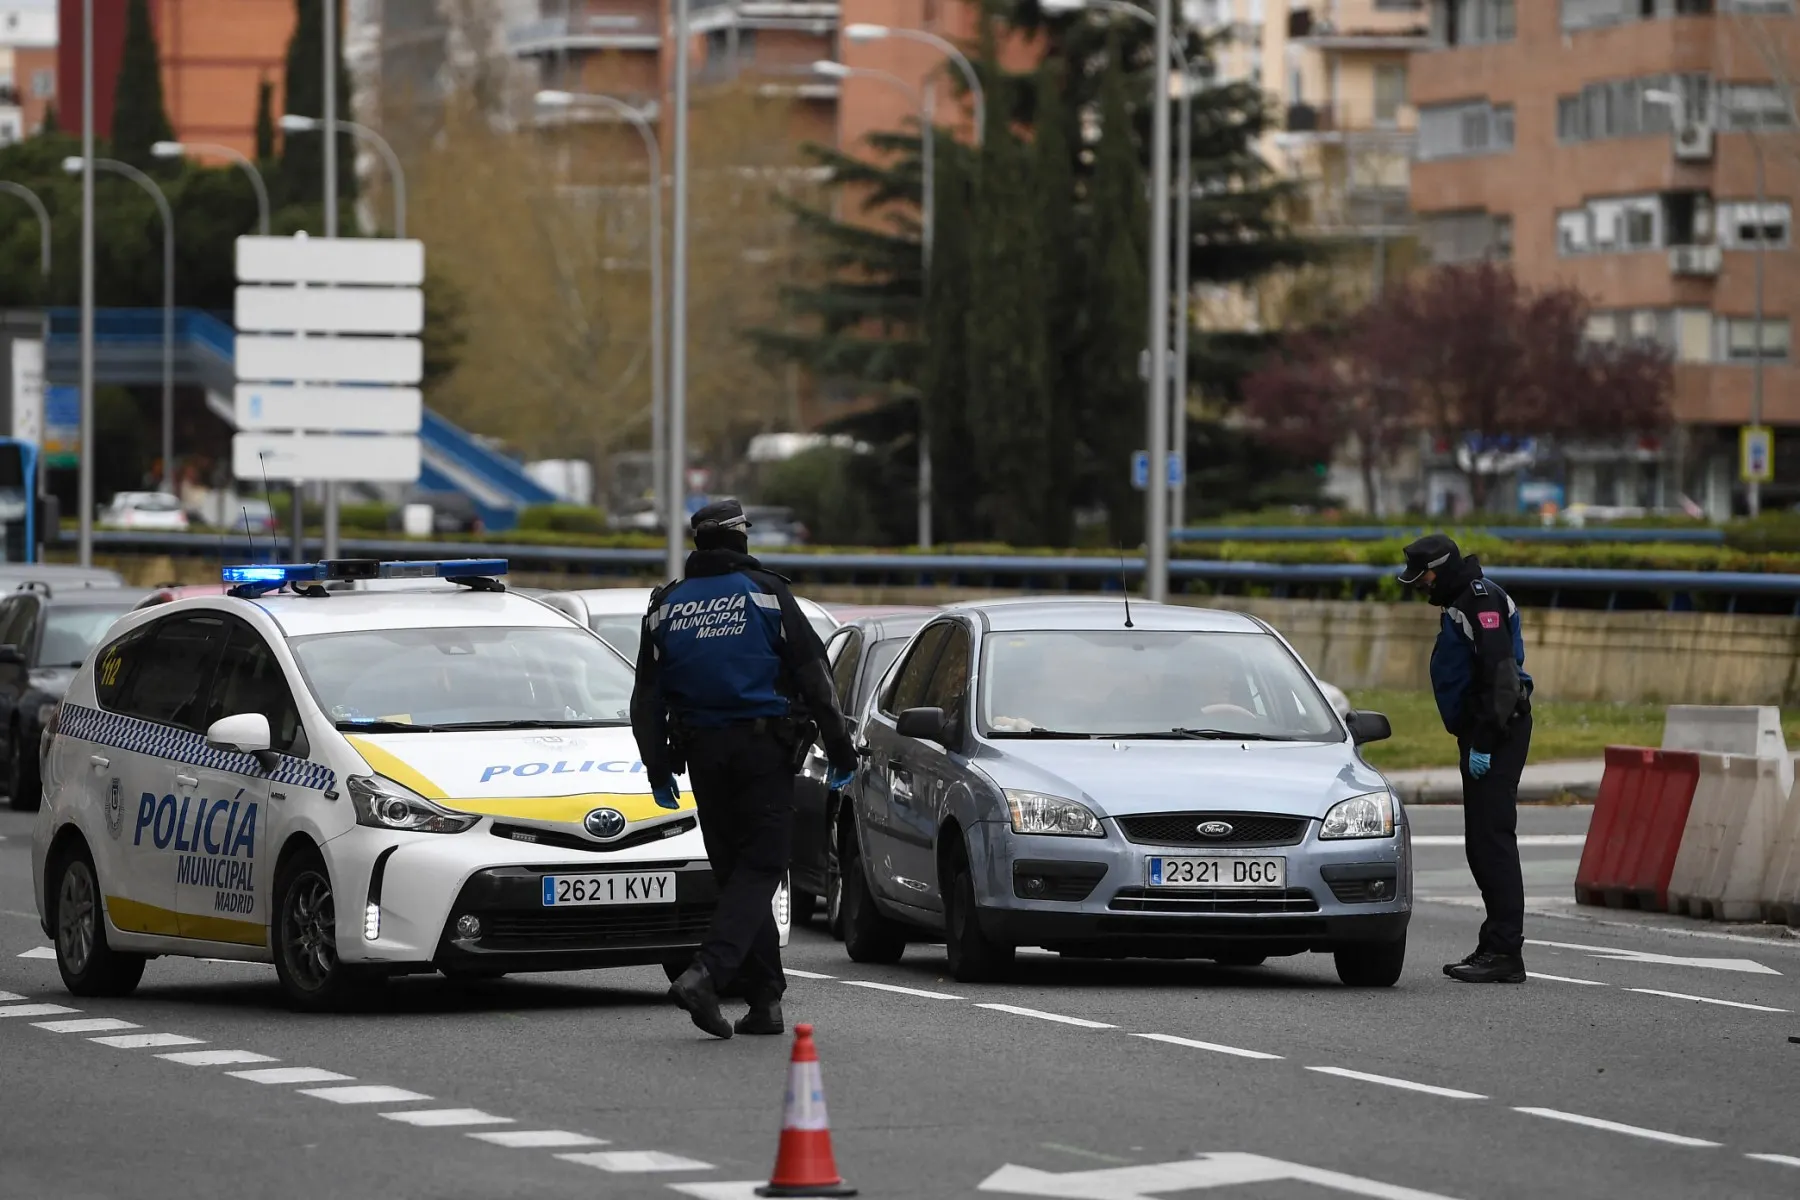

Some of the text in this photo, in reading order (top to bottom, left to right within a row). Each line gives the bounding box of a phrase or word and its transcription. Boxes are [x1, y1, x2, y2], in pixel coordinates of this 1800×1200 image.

[669, 593, 746, 618] POLICÍA
[670, 611, 747, 631] MUNICIPAL
[696, 623, 746, 638] Madrid
[101, 657, 121, 685] 112
[133, 788, 258, 858] POLICÍA
[1205, 824, 1224, 833] Ford
[177, 855, 254, 891] MUNICIPAL
[1166, 861, 1277, 882] 2321 DGC
[558, 876, 667, 902] 2621 KVY
[214, 891, 254, 914] MADRID
